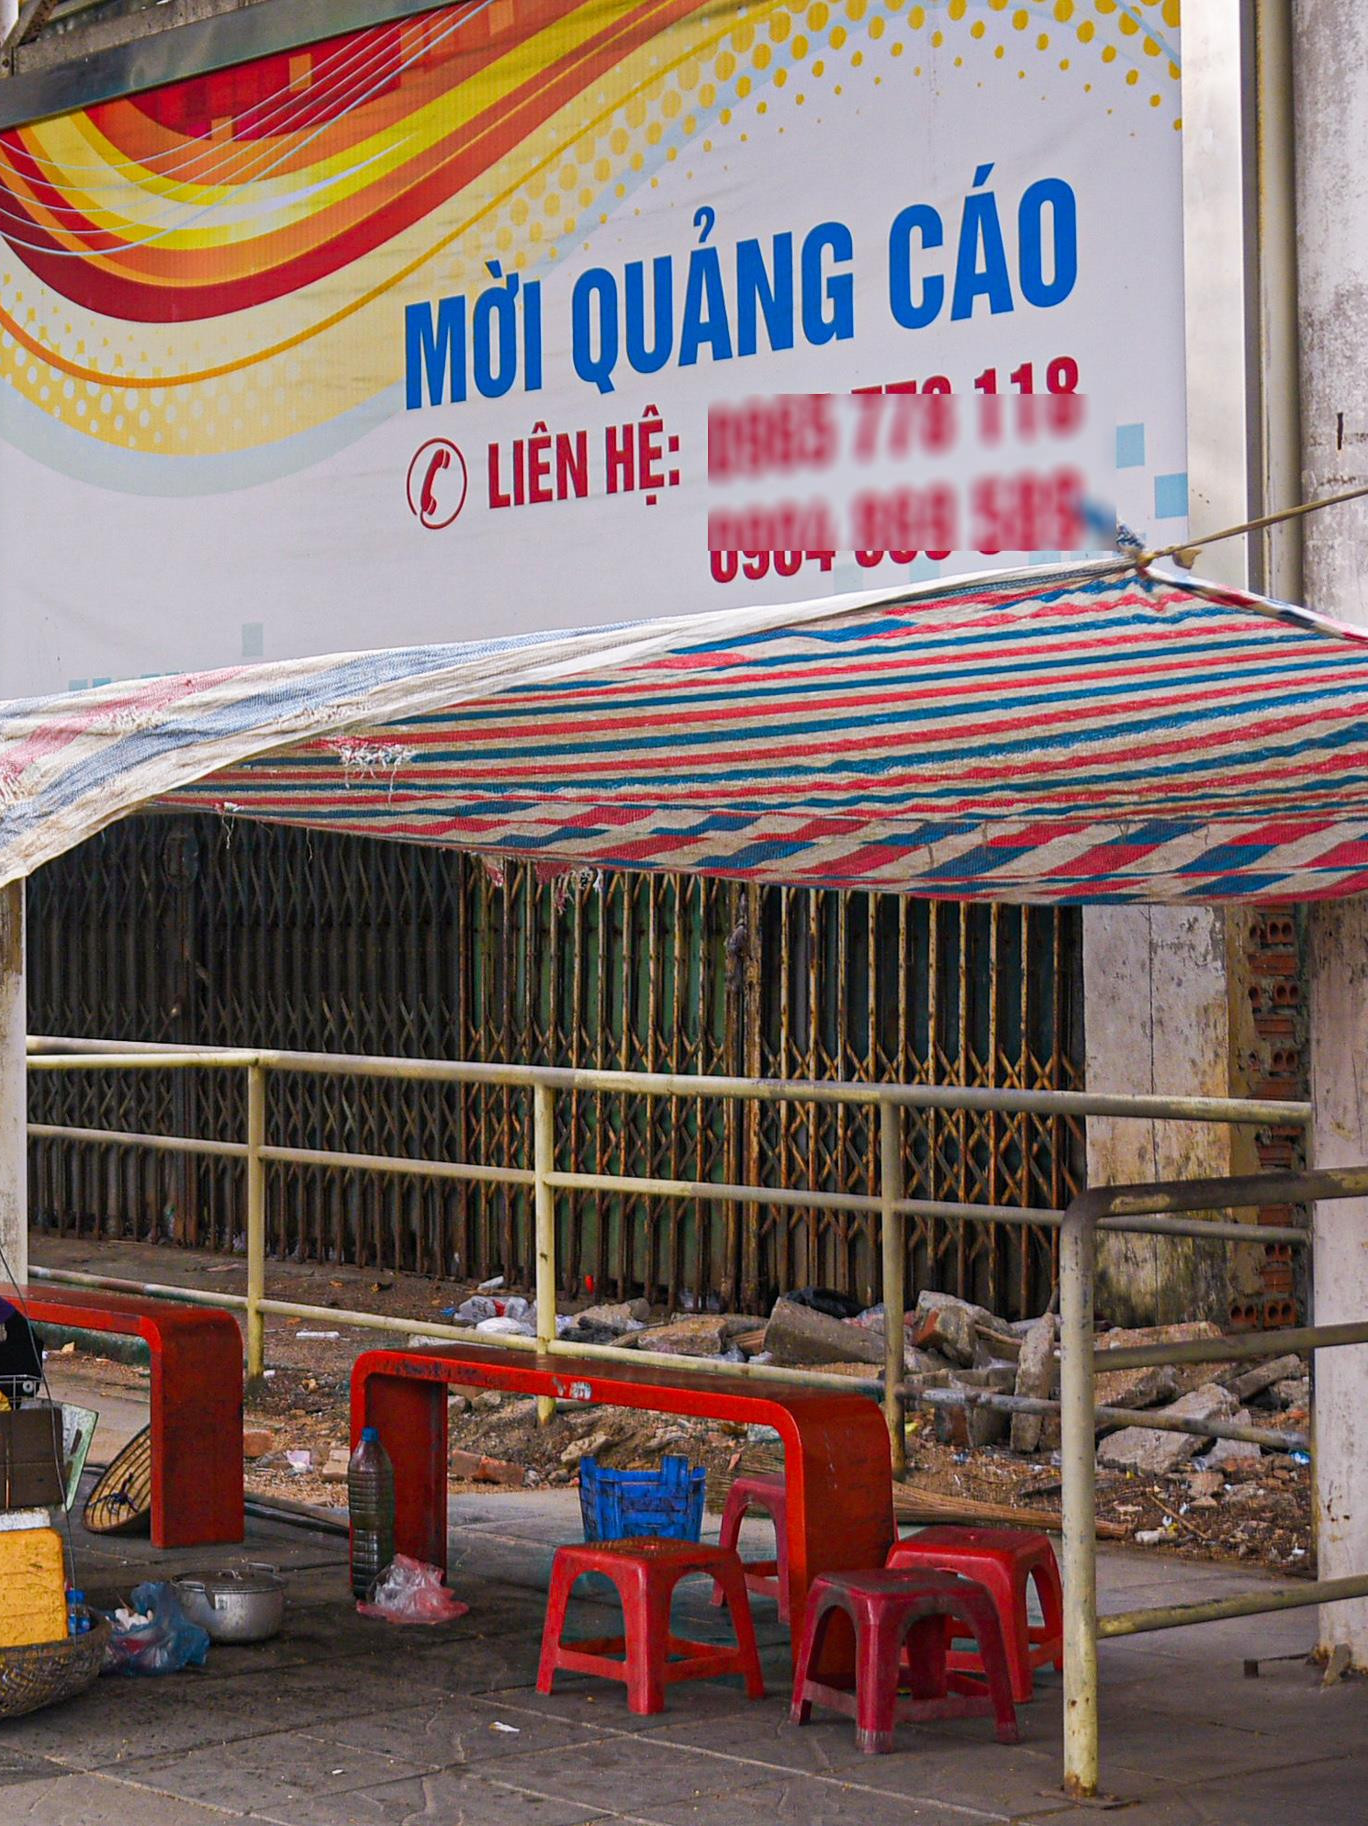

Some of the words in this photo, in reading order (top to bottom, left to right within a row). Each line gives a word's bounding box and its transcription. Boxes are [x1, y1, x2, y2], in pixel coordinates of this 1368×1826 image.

[404, 260, 543, 410] MỜI
[571, 205, 855, 394] QUẢNG
[888, 162, 1078, 330] CÁO
[486, 420, 589, 510] LIÊN
[604, 403, 681, 507] HỆ:
